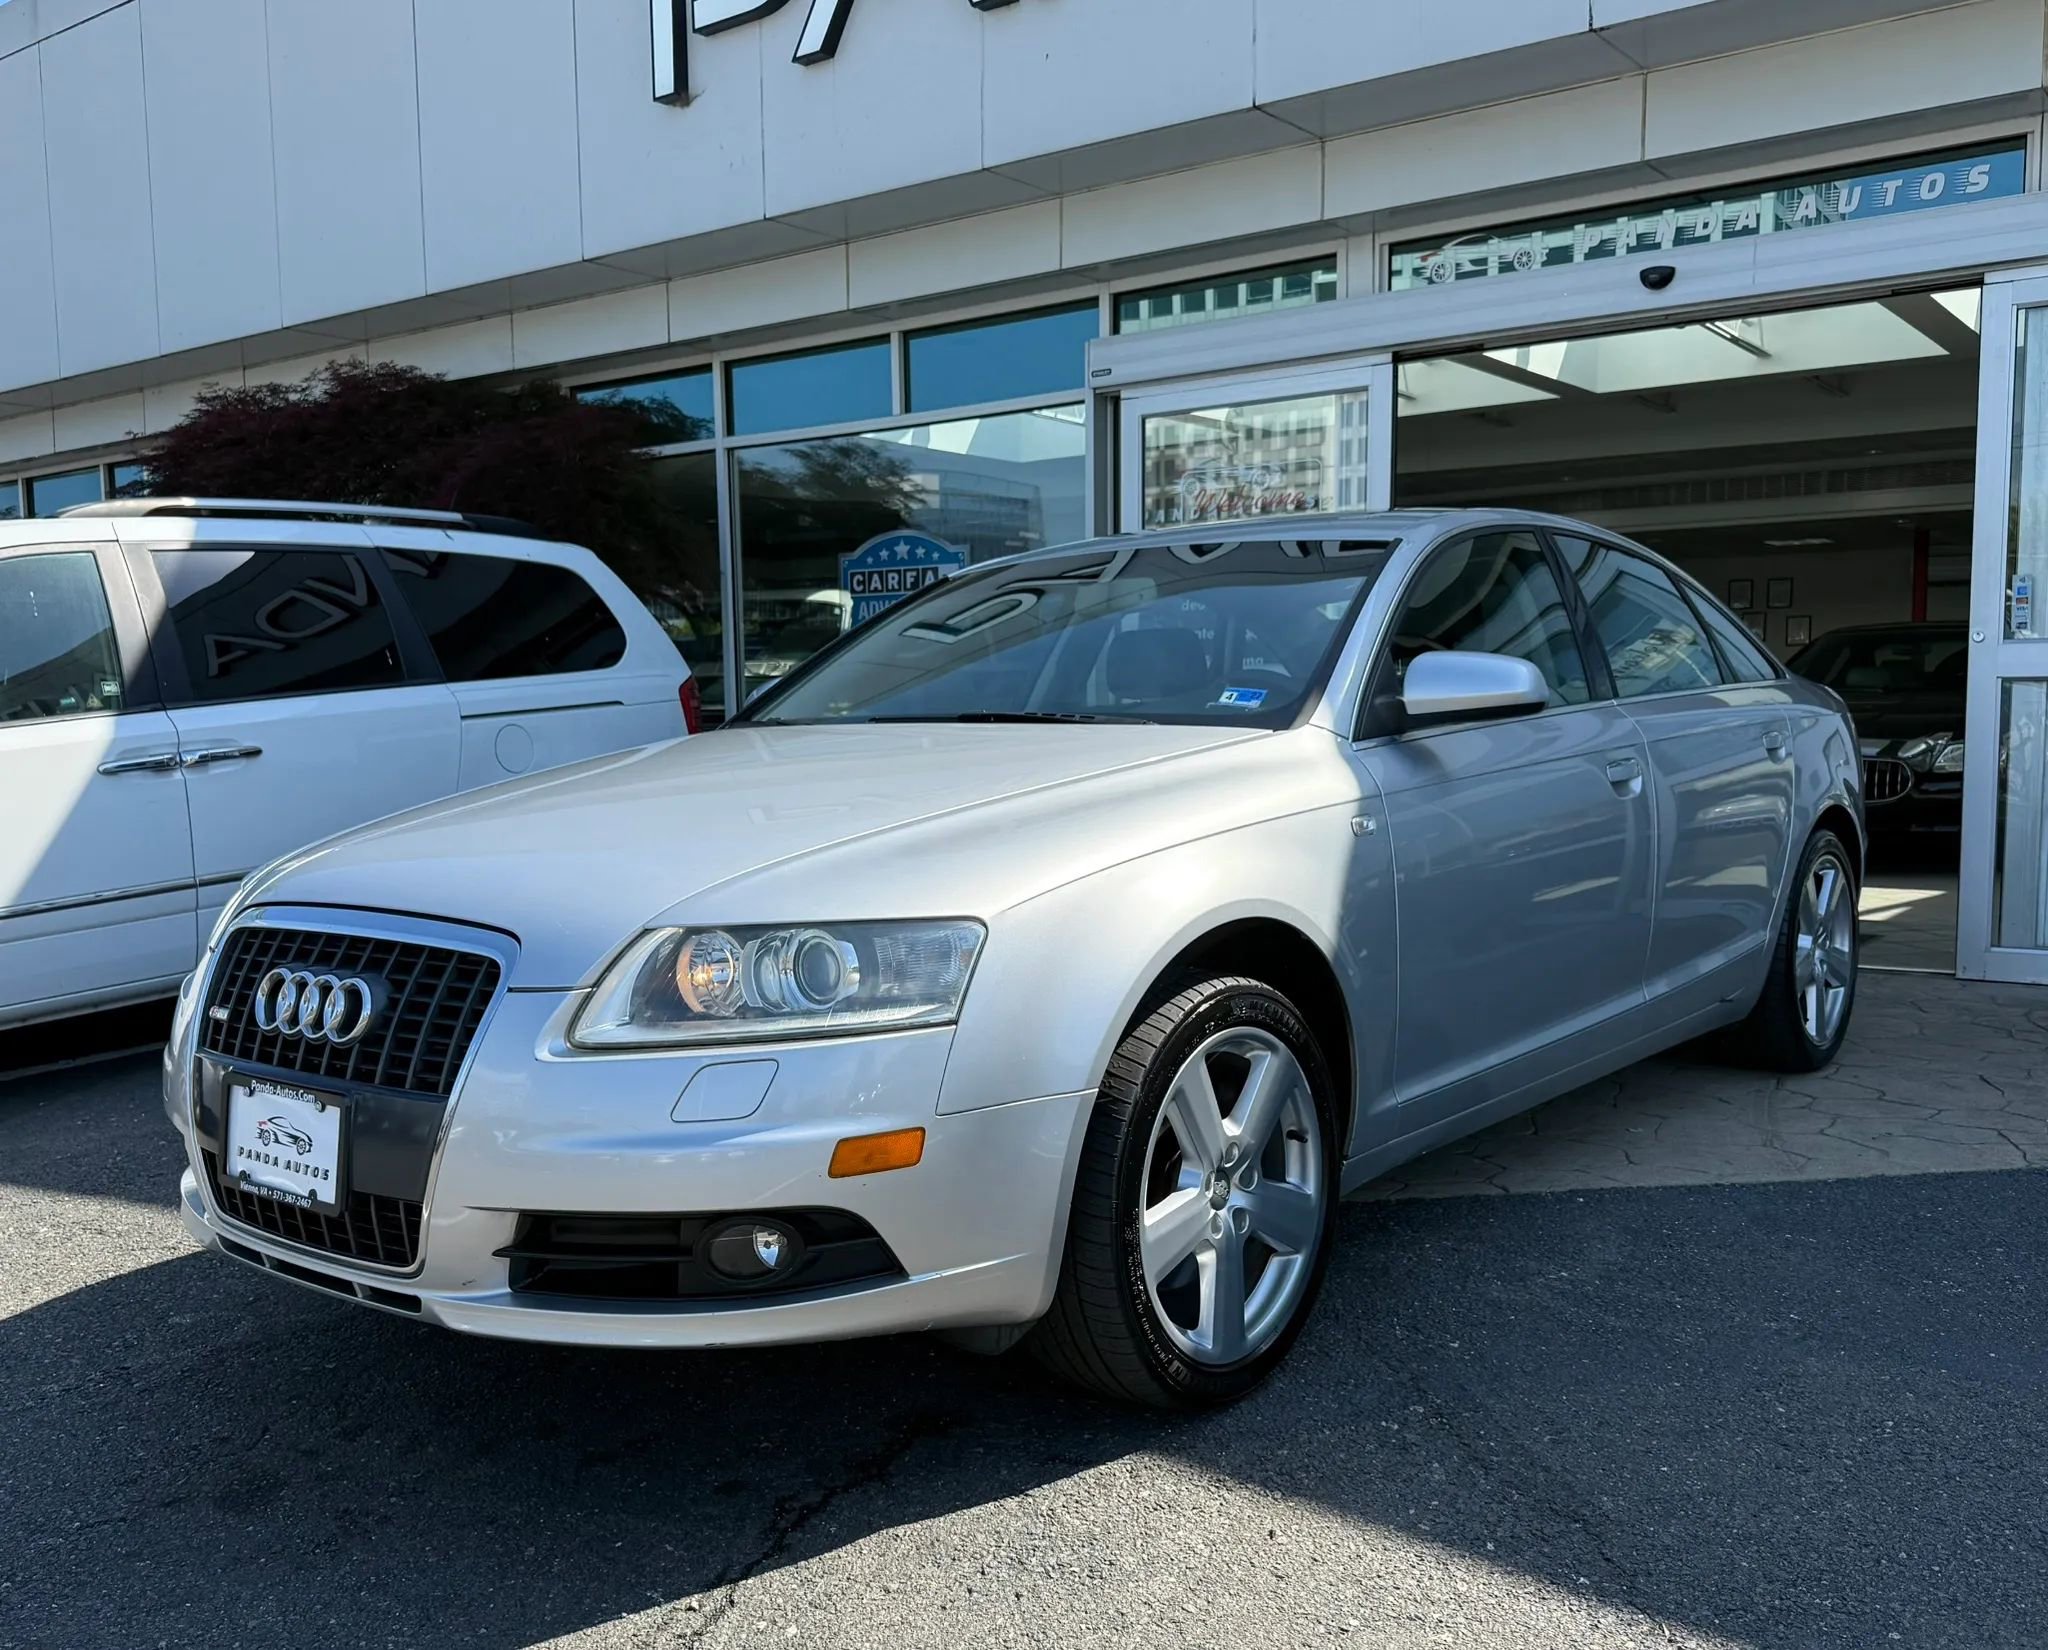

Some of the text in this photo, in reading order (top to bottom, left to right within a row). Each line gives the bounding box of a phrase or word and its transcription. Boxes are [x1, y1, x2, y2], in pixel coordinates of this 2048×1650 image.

[1578, 164, 1991, 254] PANDA AUTOS
[852, 568, 940, 592] CARFA
[1225, 693, 1235, 701] 4
[251, 1079, 315, 1104] Panda-Autos.Com
[237, 1146, 330, 1181] PANDA AUTOS
[260, 1186, 268, 1196] VA
